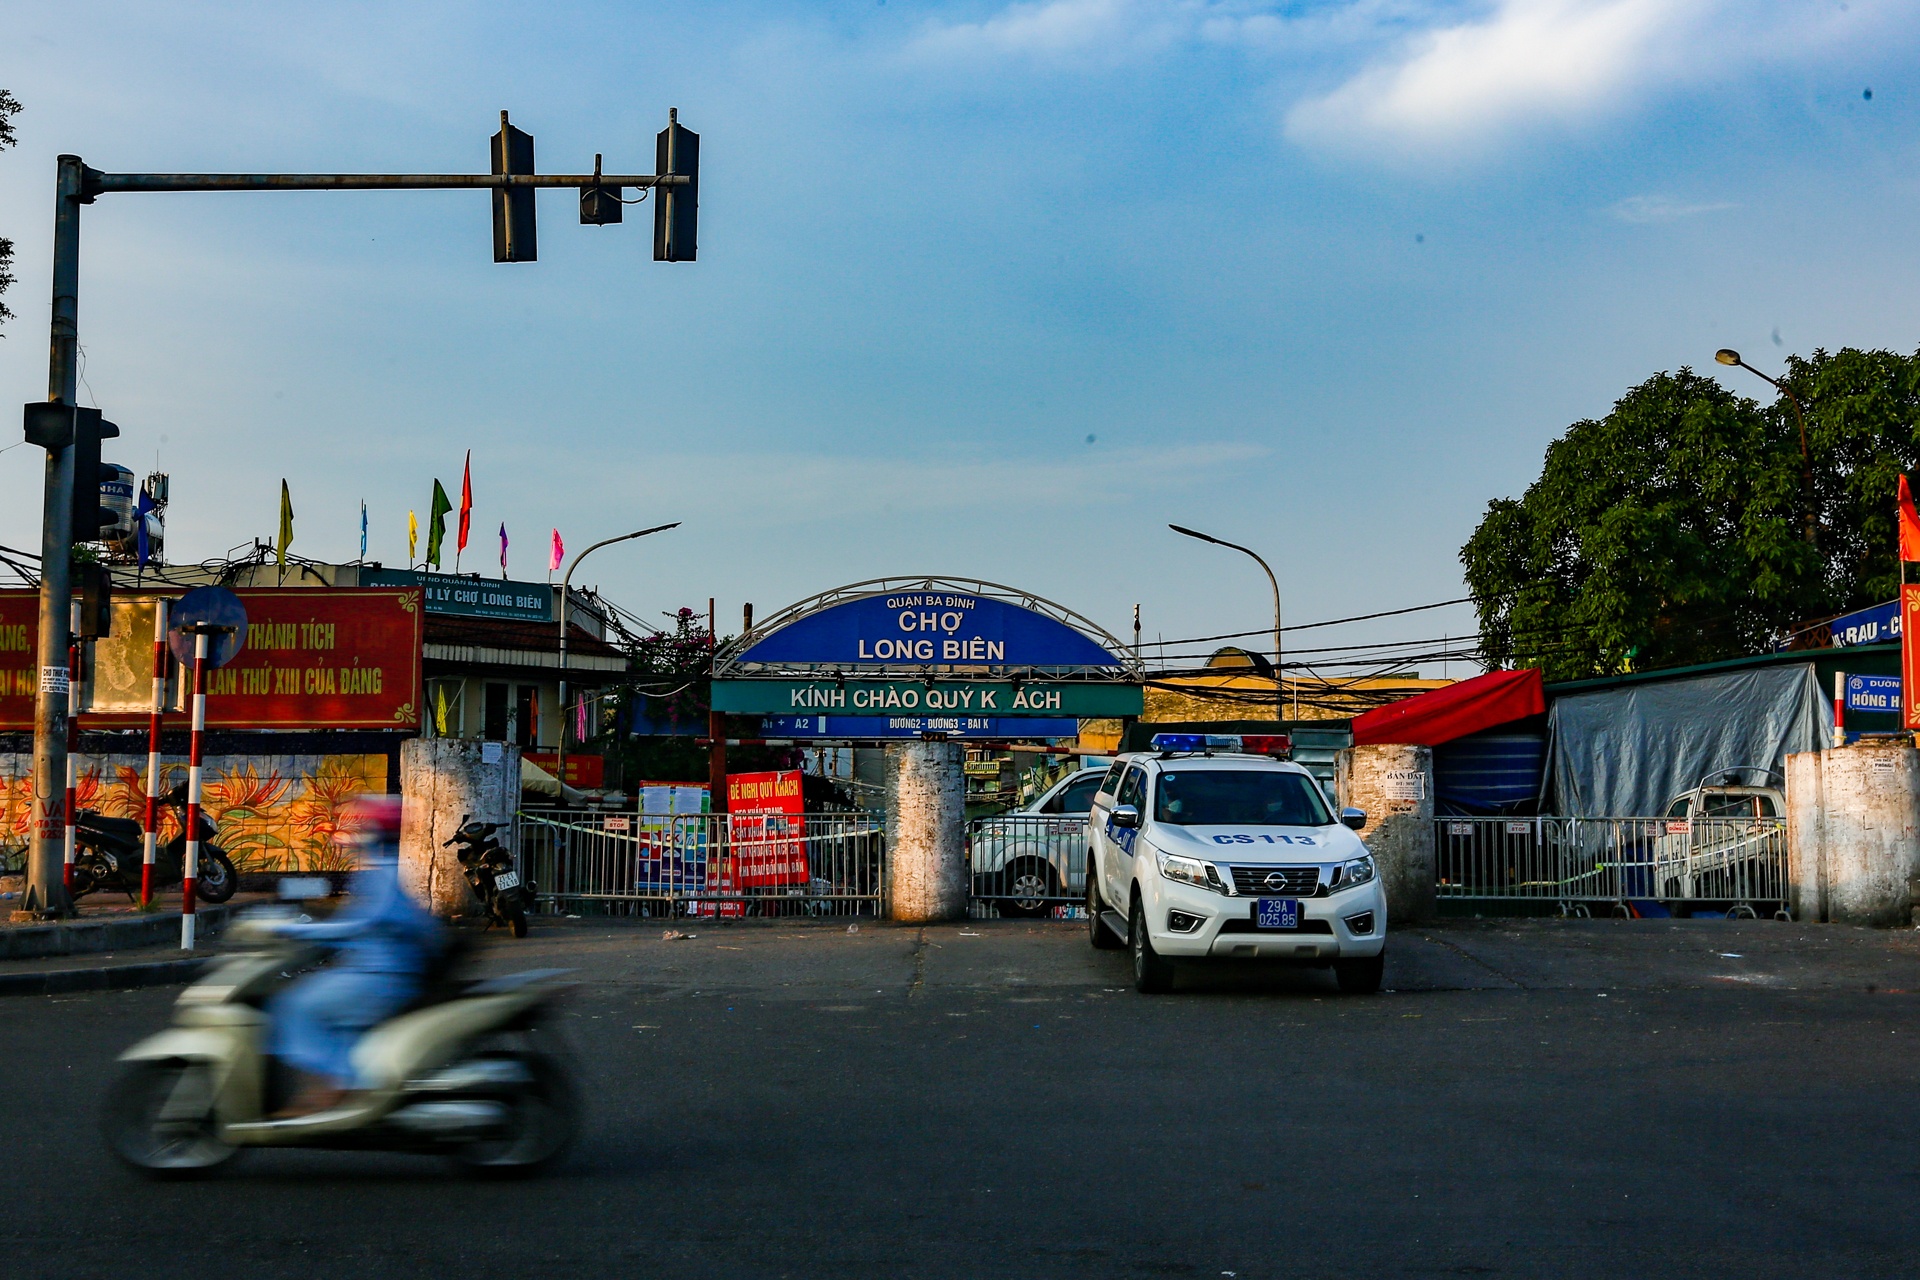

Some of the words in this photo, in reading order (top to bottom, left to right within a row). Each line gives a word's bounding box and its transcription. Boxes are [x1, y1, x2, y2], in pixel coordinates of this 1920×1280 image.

[437, 586, 451, 601] LÝ
[454, 590, 478, 606] CHỢ
[482, 593, 513, 607] LONG
[516, 594, 542, 609] BIÊN
[887, 595, 922, 609] QUẬN
[925, 596, 943, 606] BA
[945, 595, 975, 610] ĐÌNH
[247, 617, 297, 649] THÀNH
[301, 617, 335, 649] TÍCH
[898, 610, 964, 636] CHỢ
[1846, 622, 1878, 644] RAU
[858, 639, 934, 659] LONG
[943, 636, 1004, 660] BIÊN
[241, 661, 273, 695] THỨ
[274, 667, 300, 695] XIII
[305, 656, 335, 695] CỦA
[340, 656, 382, 695] ĐẢNG
[1869, 680, 1902, 688] ĐƯỜN
[791, 685, 845, 708] KÍNH
[853, 686, 919, 708] CHÀO
[925, 686, 975, 710] QUÝ
[1851, 689, 1887, 708] HỒNG
[795, 718, 809, 729] A2
[730, 778, 740, 800] ĐỀ
[741, 783, 758, 802] NGHỊ
[759, 778, 773, 800] QUÝ
[774, 777, 798, 797] KHÁCH
[1212, 834, 1255, 845] CS
[1258, 834, 1316, 846] 113
[1267, 900, 1288, 913] 29A
[1259, 913, 1295, 926] 025.85
